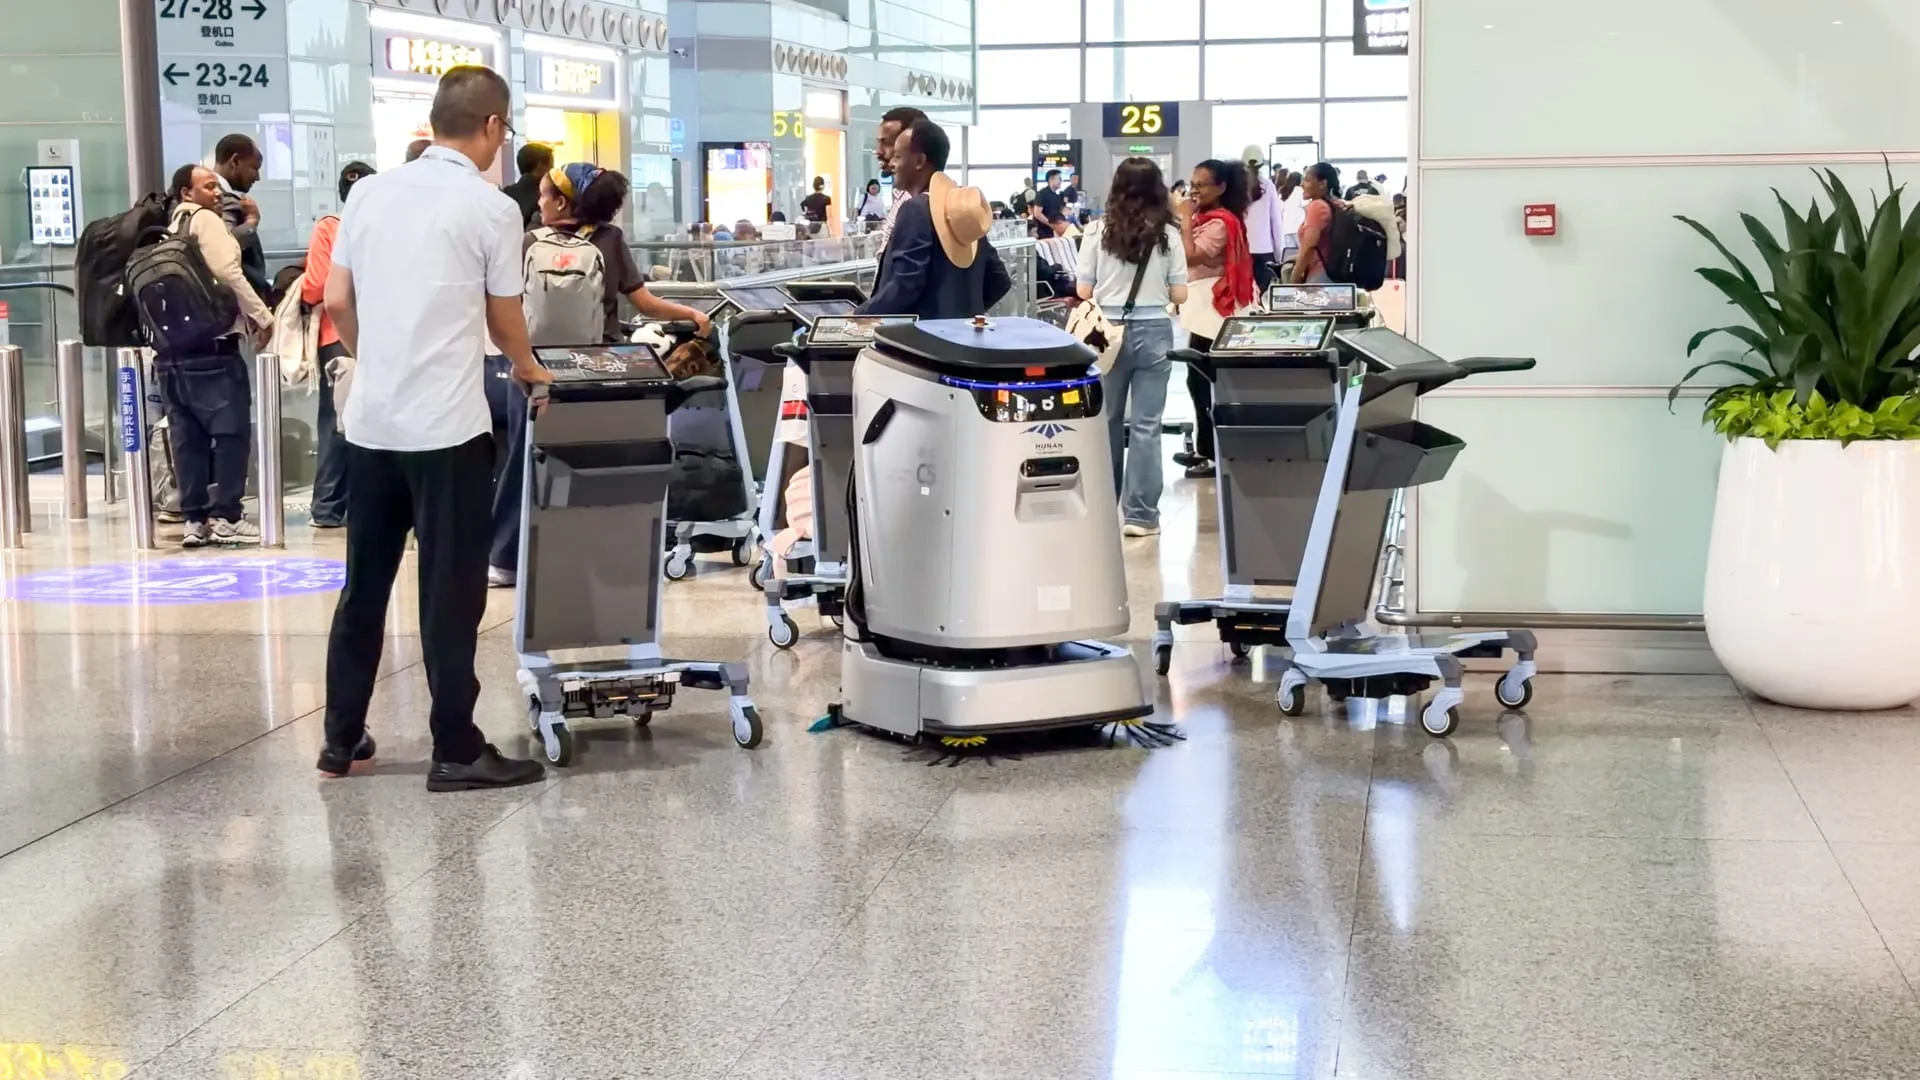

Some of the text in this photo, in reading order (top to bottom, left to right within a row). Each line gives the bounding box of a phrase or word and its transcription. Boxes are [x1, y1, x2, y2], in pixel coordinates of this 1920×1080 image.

[160, 0, 233, 20] 27-28
[201, 26, 234, 38] 登机口
[196, 63, 269, 87] 23-24
[198, 93, 231, 105] 登机口
[1121, 105, 1162, 133] 25
